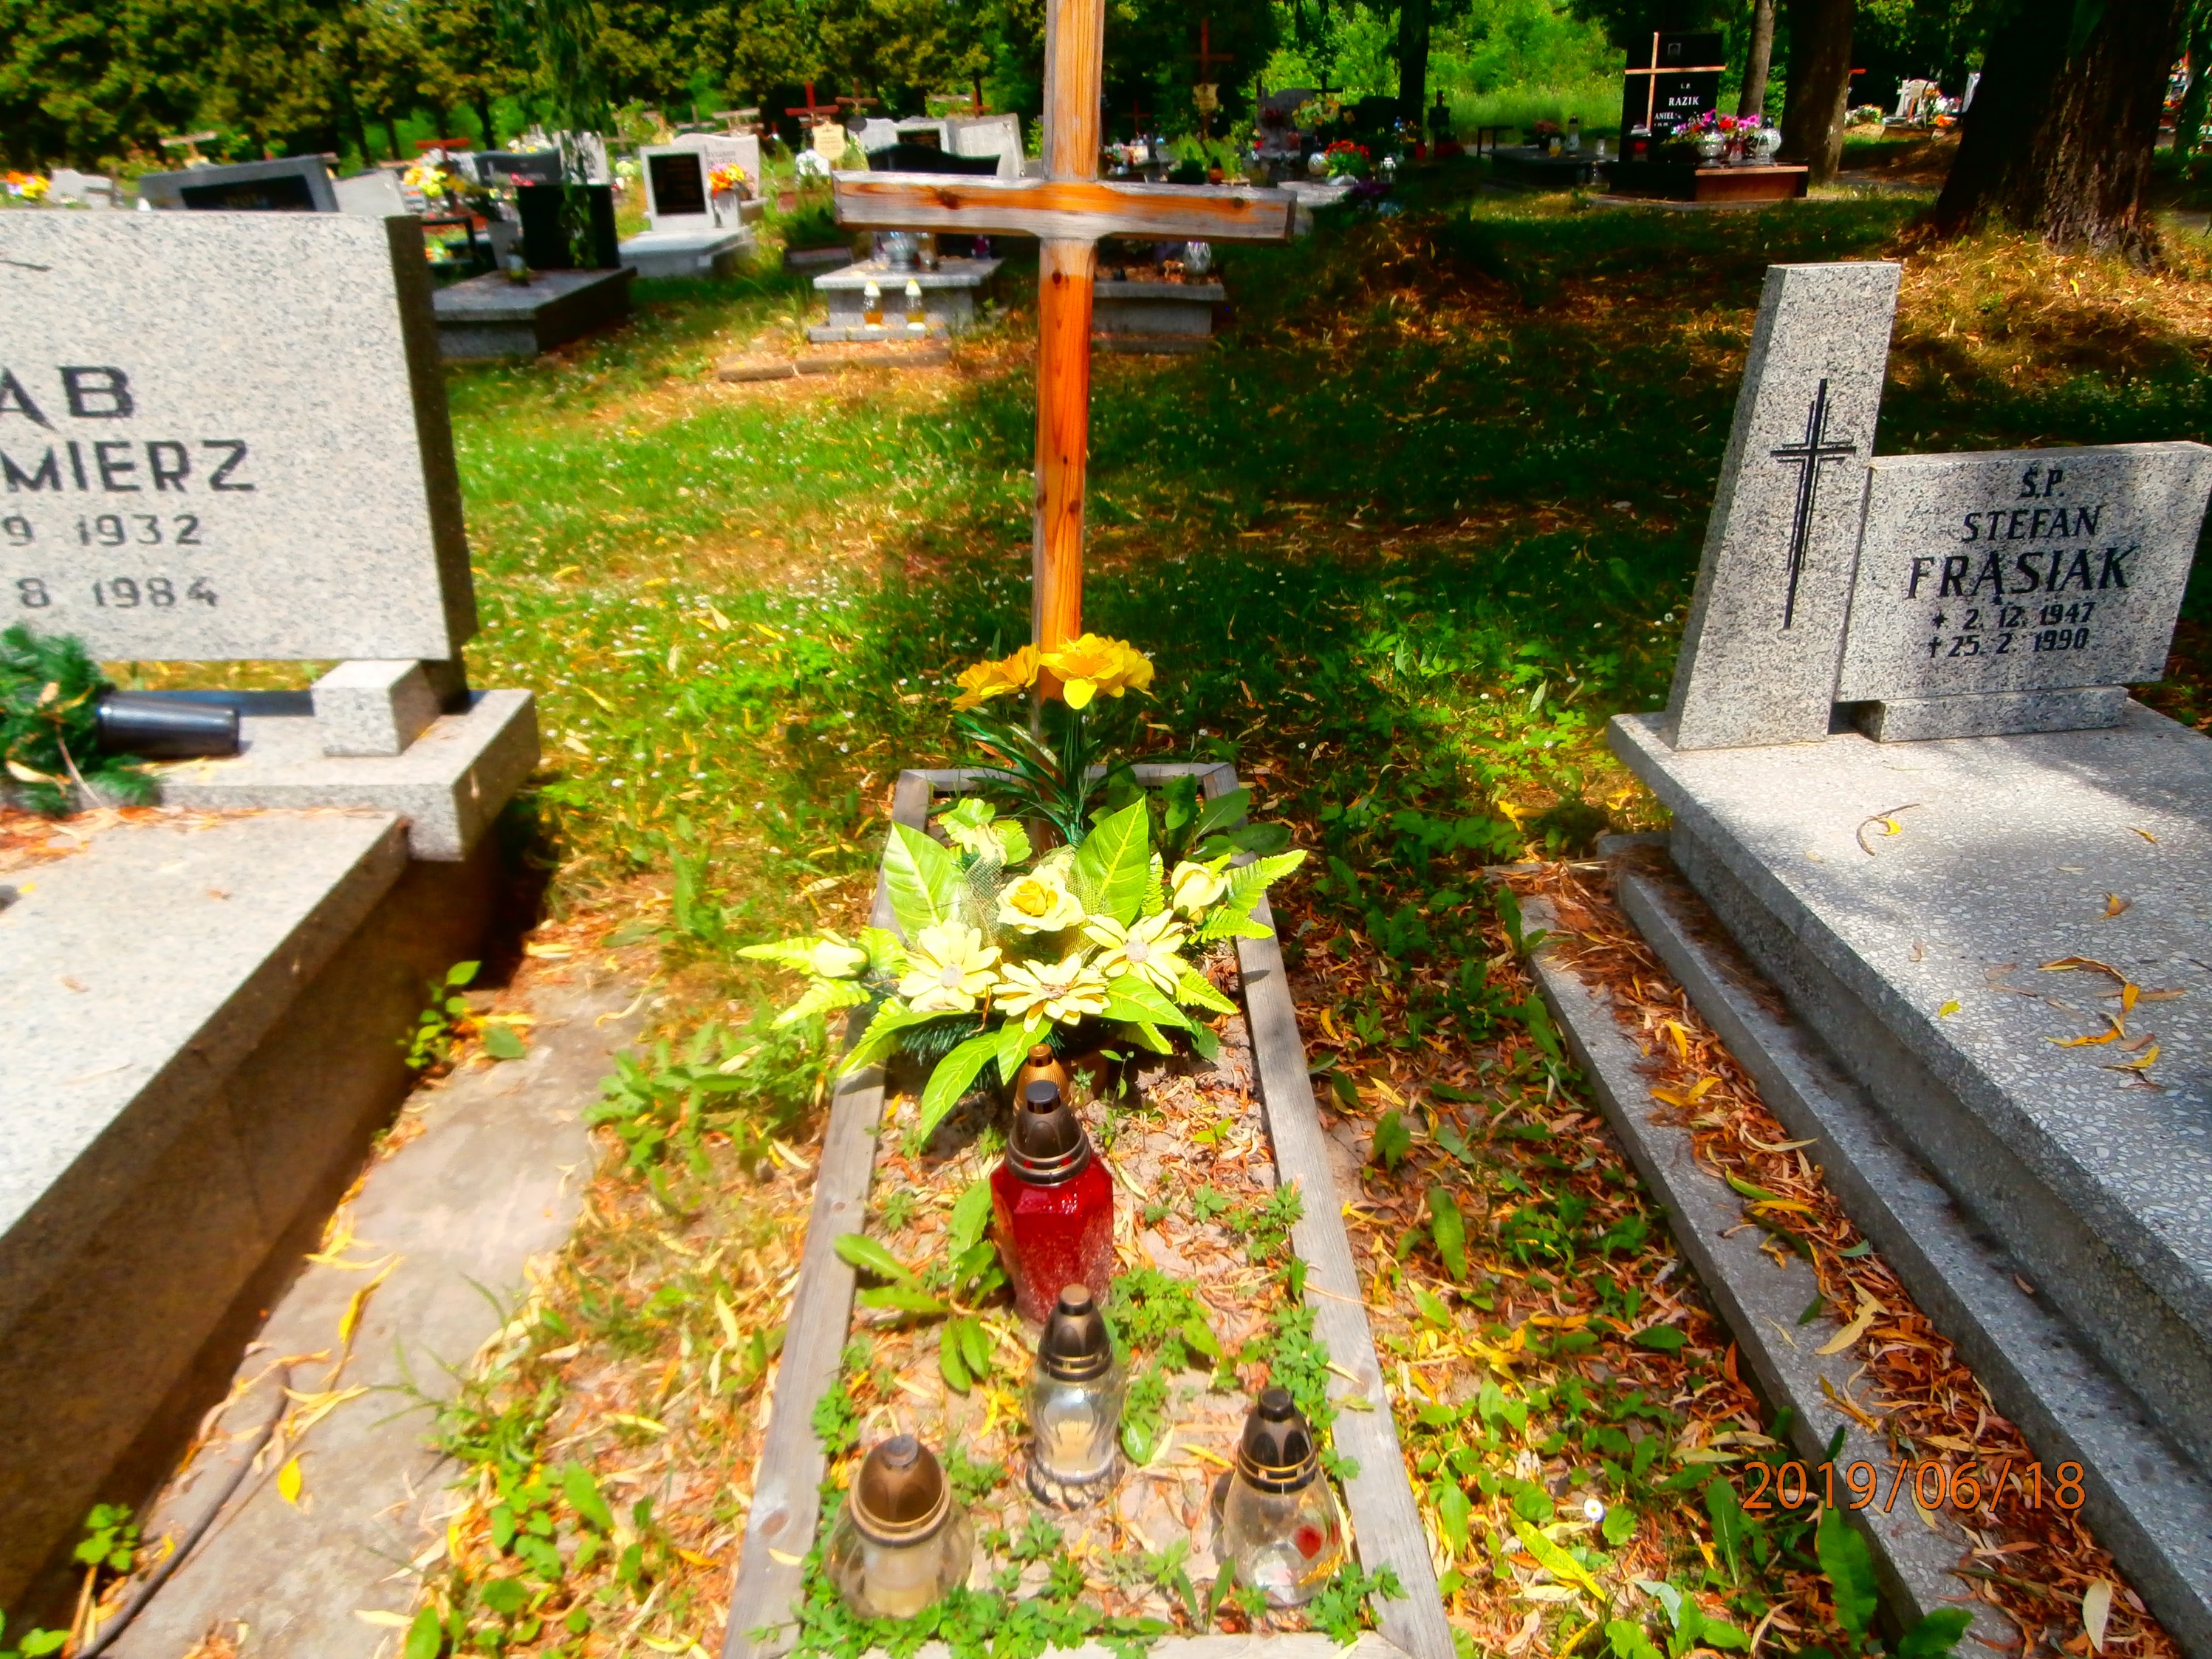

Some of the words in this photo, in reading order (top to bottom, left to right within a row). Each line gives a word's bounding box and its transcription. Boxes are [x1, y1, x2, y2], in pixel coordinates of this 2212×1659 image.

[1668, 96, 1699, 106] RAZIK
[1654, 112, 1677, 120] ANIEL
[76, 514, 202, 546] 1932
[1962, 505, 2103, 543] STEFAN
[16, 577, 51, 608] 8
[92, 576, 218, 608] 1984
[2039, 601, 2096, 626] 1947
[2033, 627, 2089, 653] 1990
